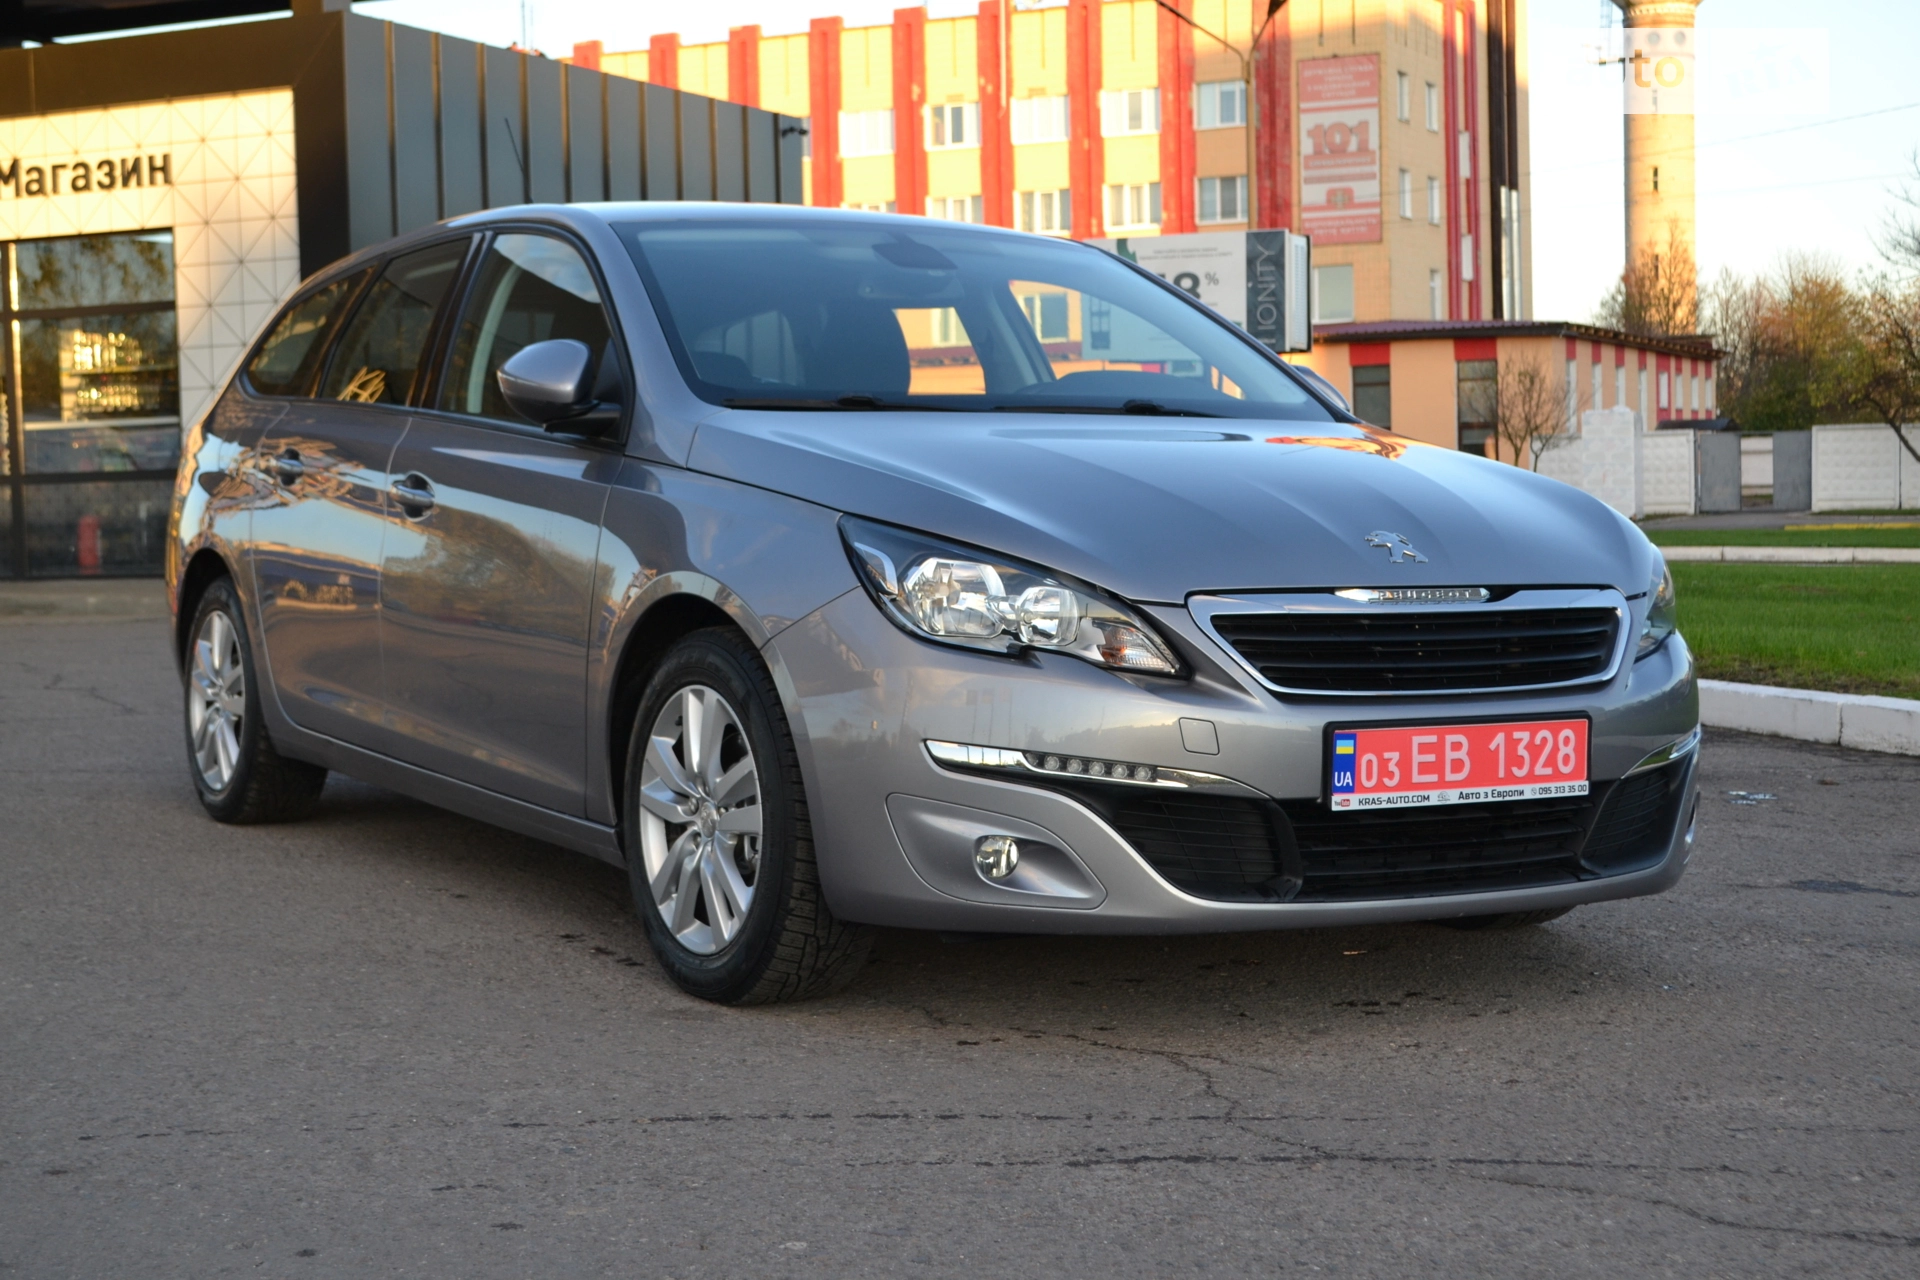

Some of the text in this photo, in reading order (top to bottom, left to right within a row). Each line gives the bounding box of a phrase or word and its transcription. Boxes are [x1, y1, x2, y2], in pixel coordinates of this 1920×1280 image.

[1306, 121, 1370, 154] 101
[0, 153, 173, 198] Магазин
[1361, 729, 1576, 788] 03 EB 1328
[1334, 772, 1353, 787] UA
[1458, 791, 1481, 801] Авто
[1538, 784, 1587, 795] 095 313 35 00
[1358, 794, 1430, 806] KRAS-AUTO.COM
